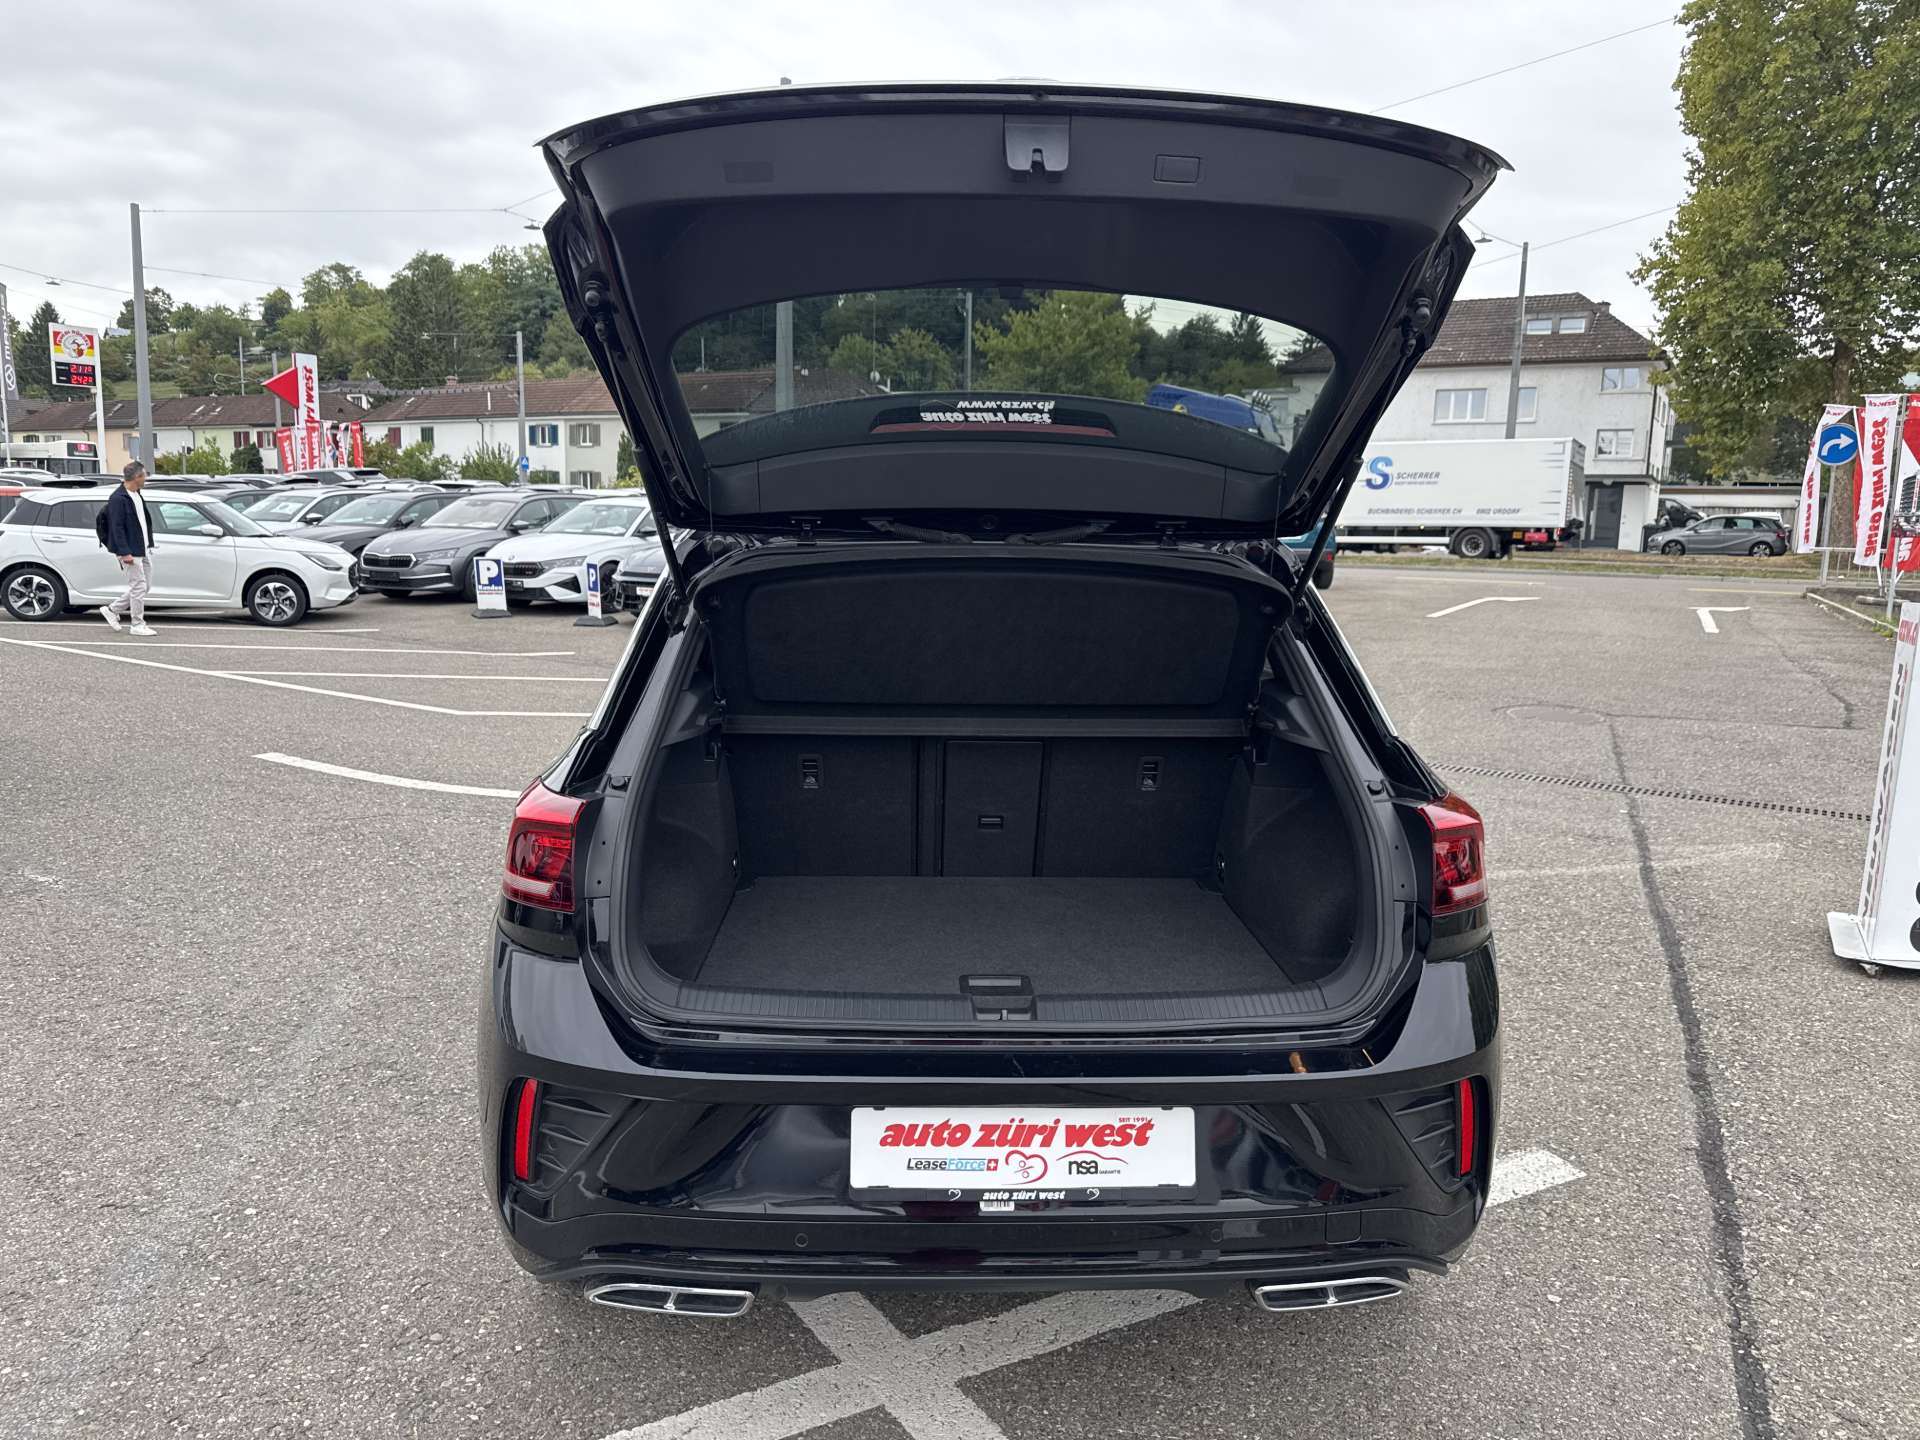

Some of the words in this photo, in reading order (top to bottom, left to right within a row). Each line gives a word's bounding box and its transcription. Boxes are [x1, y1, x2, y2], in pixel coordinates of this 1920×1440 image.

[303, 365, 314, 403] west
[1396, 471, 1440, 480] SCHERRER
[478, 560, 499, 585] P
[588, 567, 596, 589] P
[880, 1118, 971, 1147] auto
[972, 1118, 1061, 1147] züri
[1065, 1118, 1154, 1147] west
[907, 1158, 986, 1171] LeaseForce
[1068, 1160, 1099, 1175] nsa
[983, 1191, 1010, 1200] auto
[1039, 1190, 1066, 1200] west
